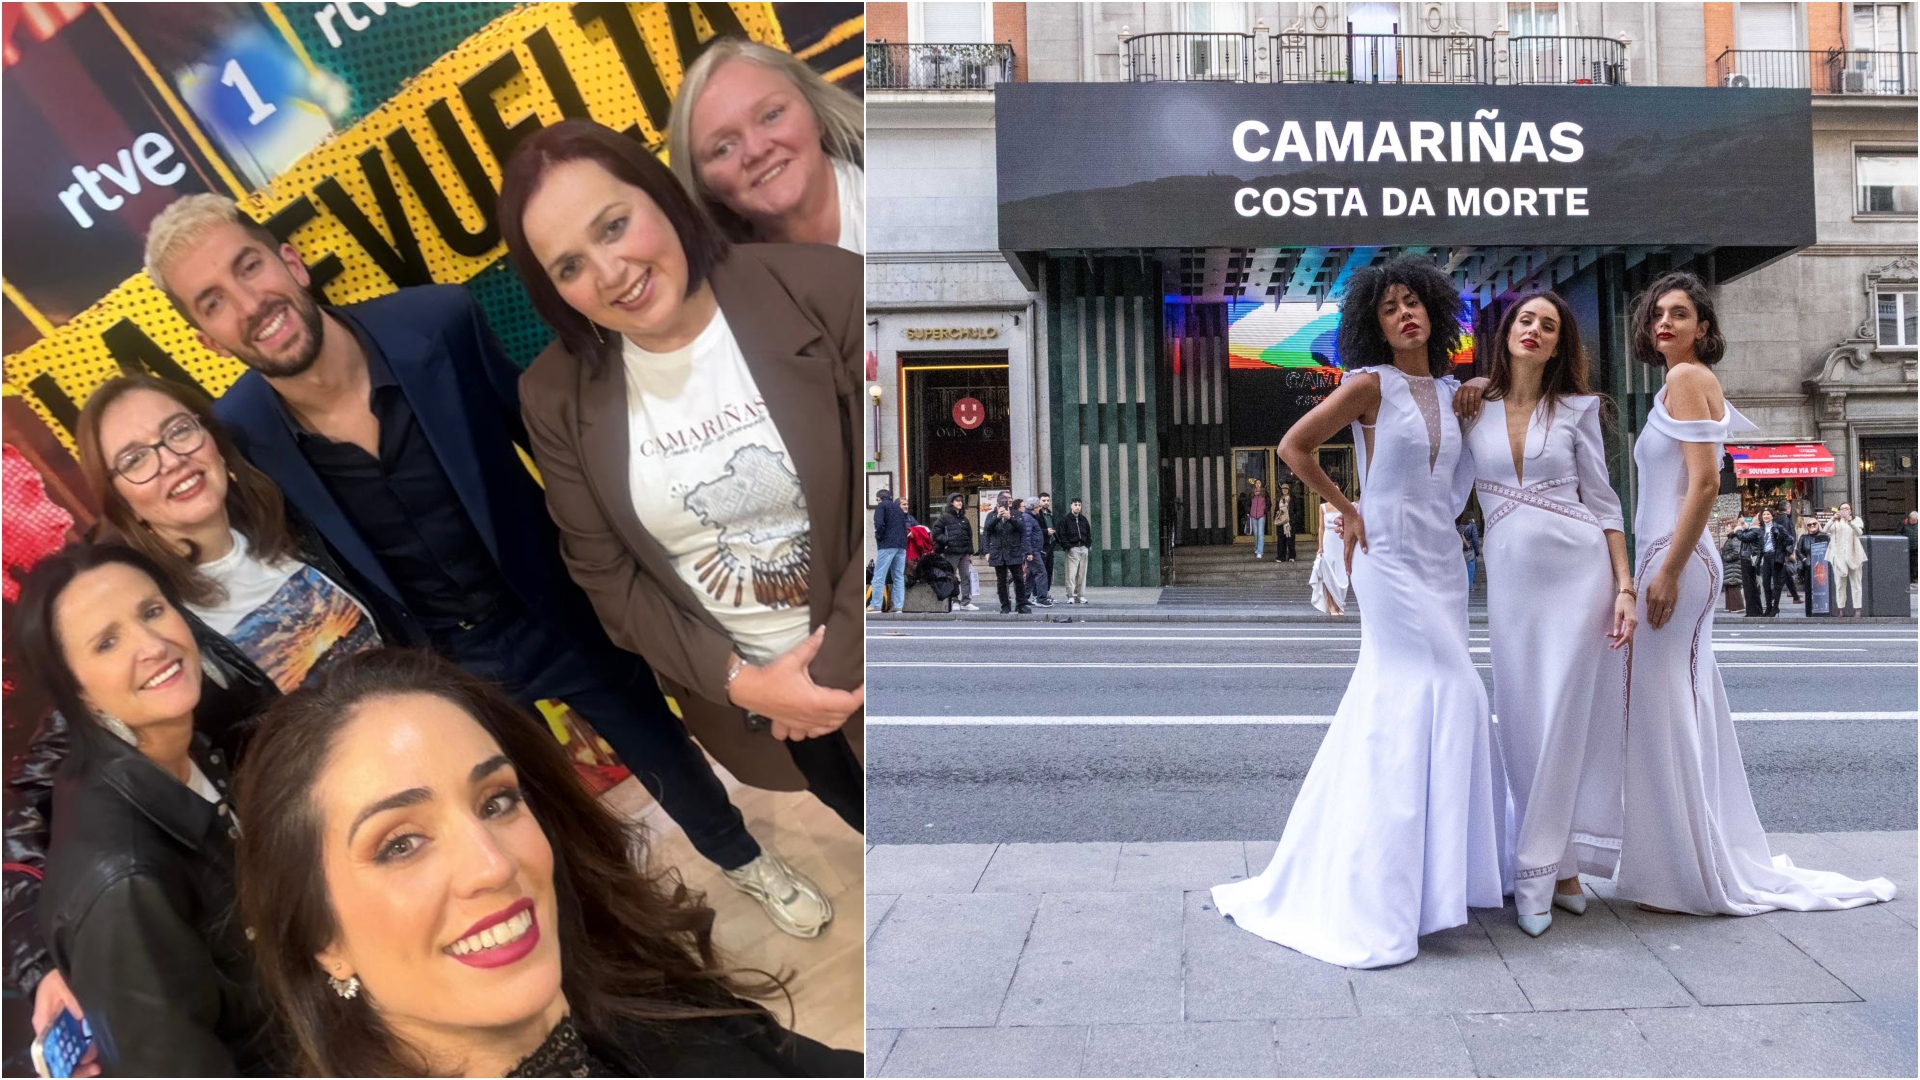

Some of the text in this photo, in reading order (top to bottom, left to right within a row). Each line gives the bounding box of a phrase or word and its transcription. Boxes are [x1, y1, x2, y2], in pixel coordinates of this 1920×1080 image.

[314, 2, 422, 49] rt
[219, 57, 275, 126] 1
[1231, 108, 1585, 163] CAMARIÑAS
[56, 130, 185, 229] rtve
[1233, 186, 1590, 217] COSTA DA MORTE
[906, 327, 997, 339] SUPERCHULO
[640, 393, 766, 458] CAMARIÑAS
[1748, 467, 1780, 475] SOUVENIRS
